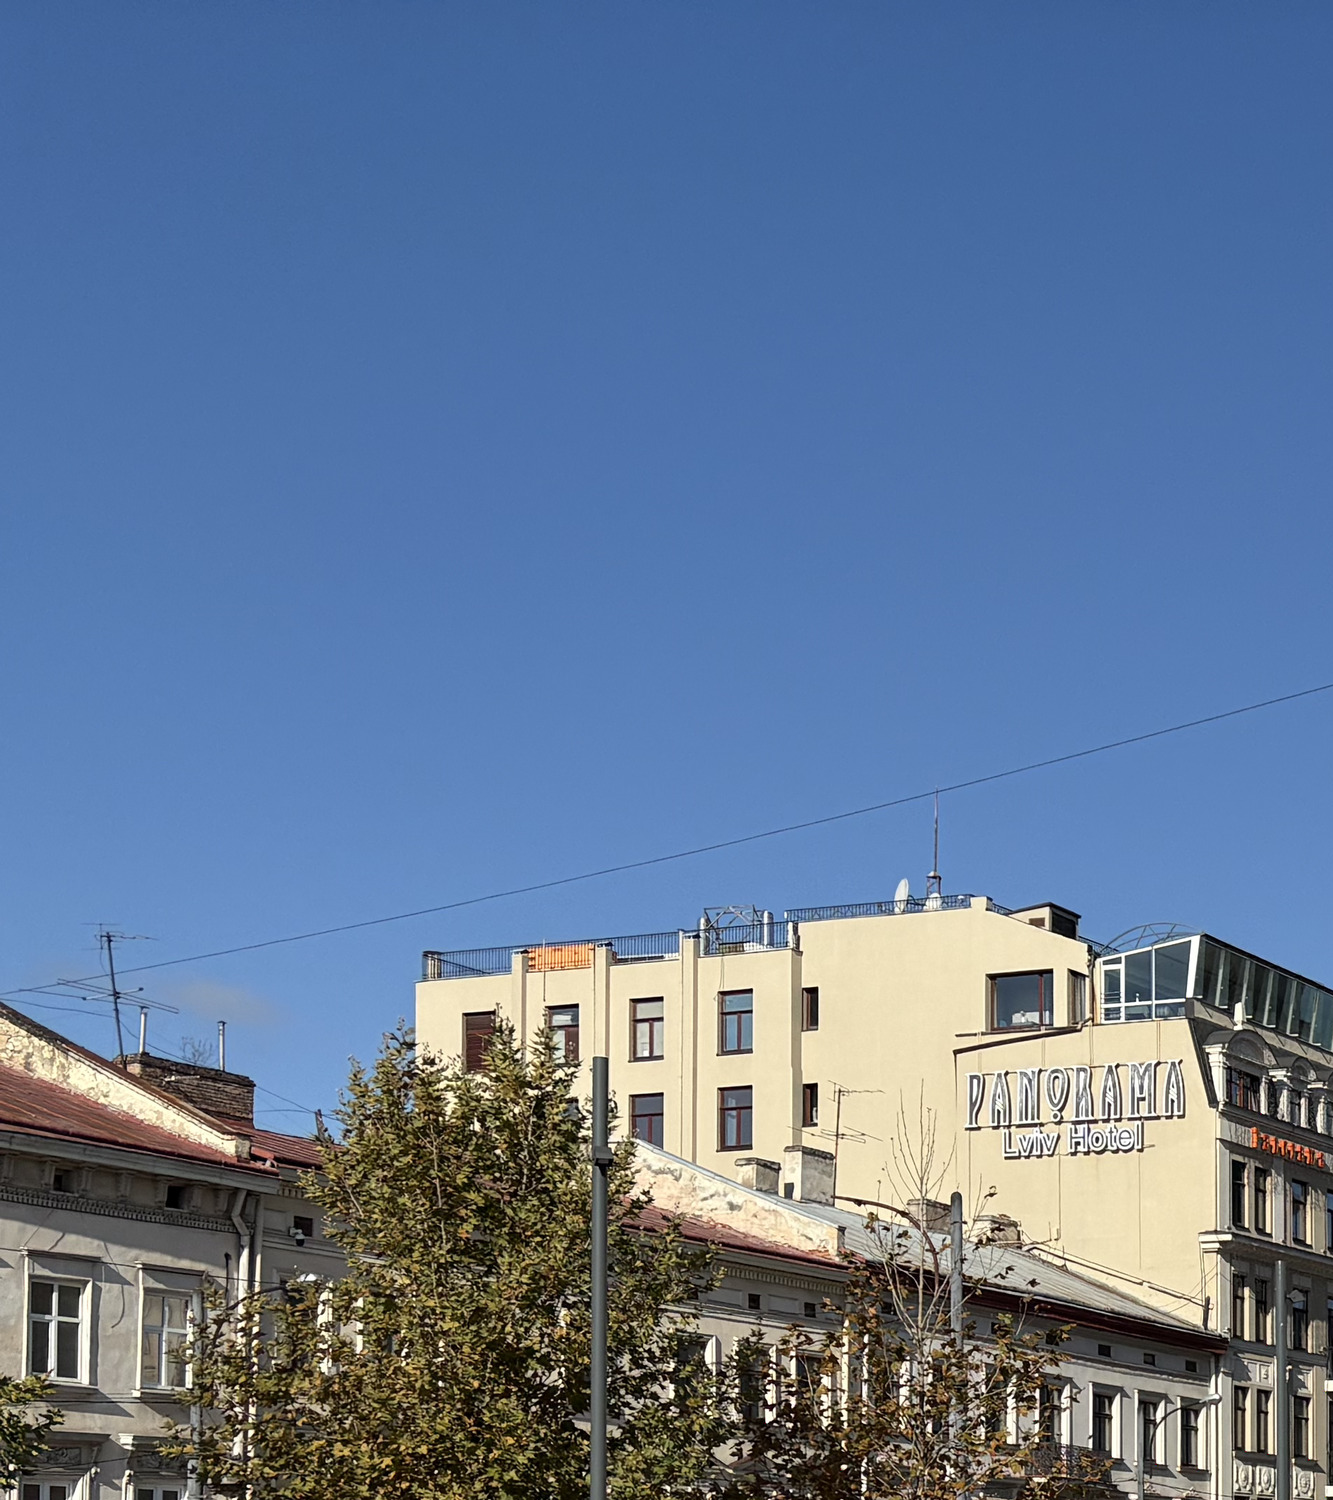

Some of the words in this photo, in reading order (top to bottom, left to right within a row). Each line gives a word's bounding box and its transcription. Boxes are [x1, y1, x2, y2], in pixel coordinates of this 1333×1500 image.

[965, 1059, 1186, 1129] PANORAMA
[1002, 1127, 1060, 1159] Lviv
[1068, 1120, 1144, 1156] Hotel
